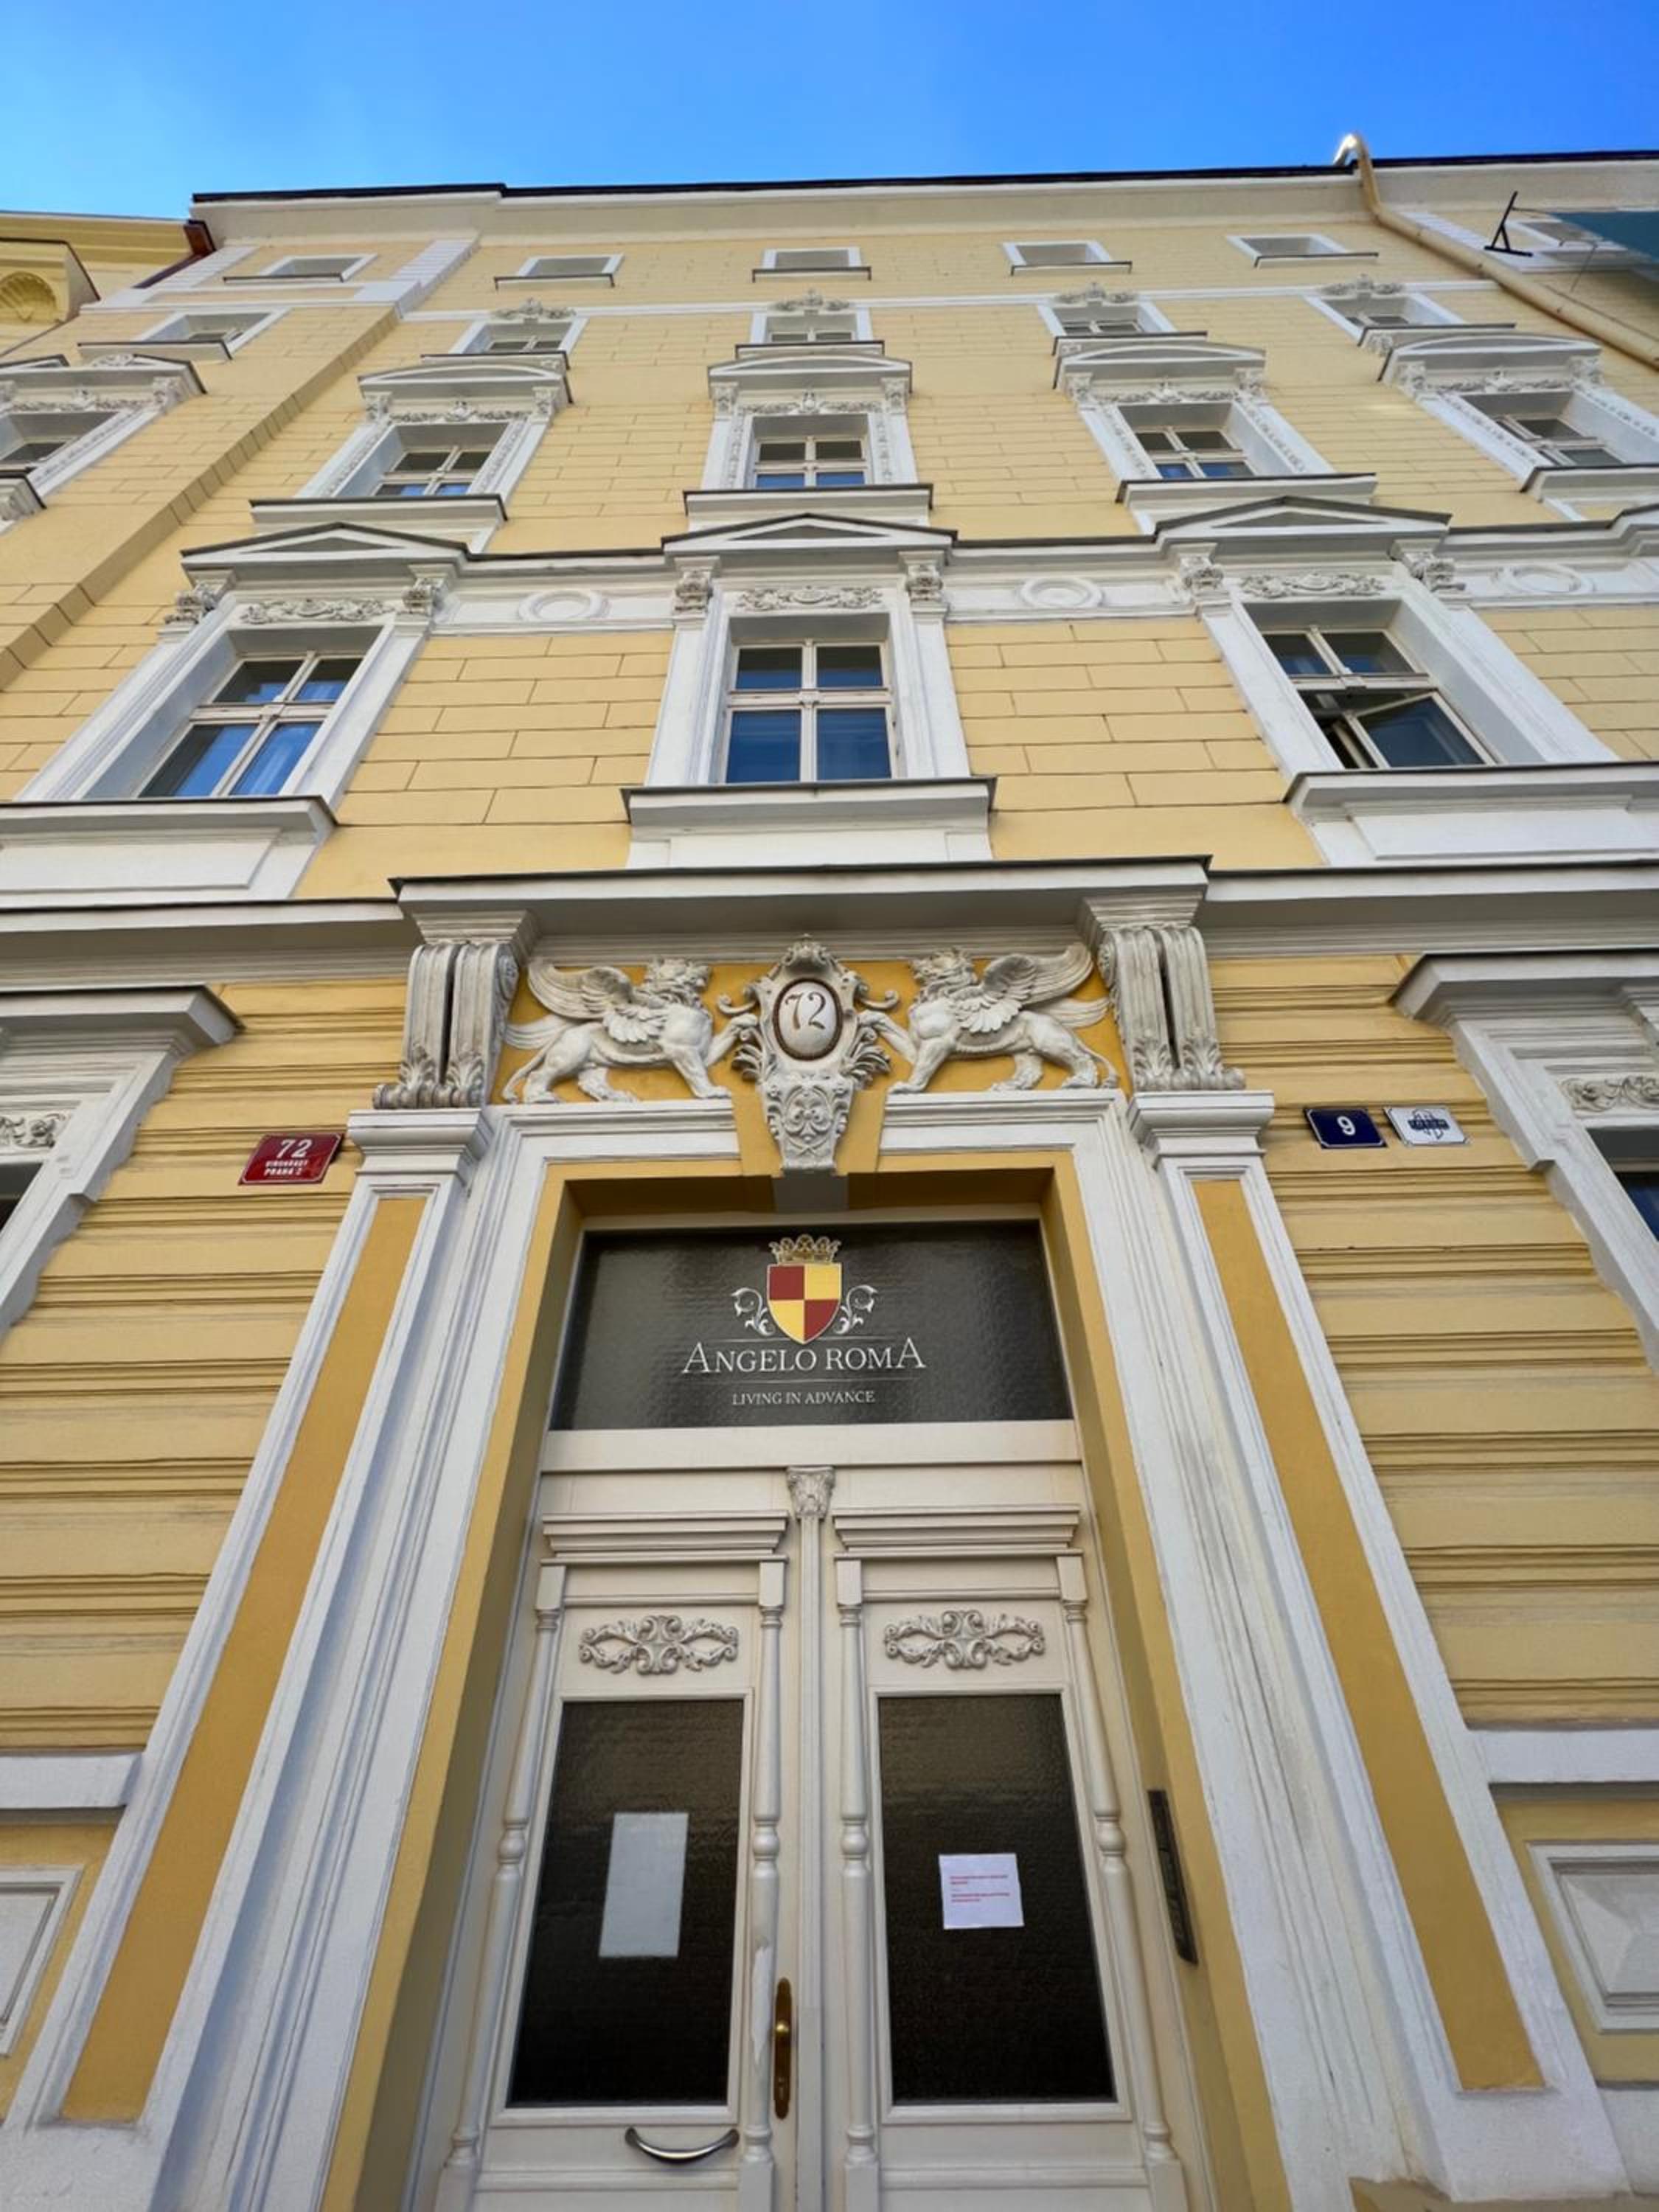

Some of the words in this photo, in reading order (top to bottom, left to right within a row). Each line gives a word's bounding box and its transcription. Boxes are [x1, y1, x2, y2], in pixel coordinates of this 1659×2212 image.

[785, 991, 826, 1030] 72
[1337, 1116, 1356, 1135] 9
[276, 1138, 313, 1159] 72
[681, 1341, 817, 1374] ANGELO
[825, 1336, 926, 1370] ROMA
[732, 1391, 782, 1405] LIVING
[785, 1391, 801, 1405] IN
[804, 1390, 875, 1405] ADVANCE
